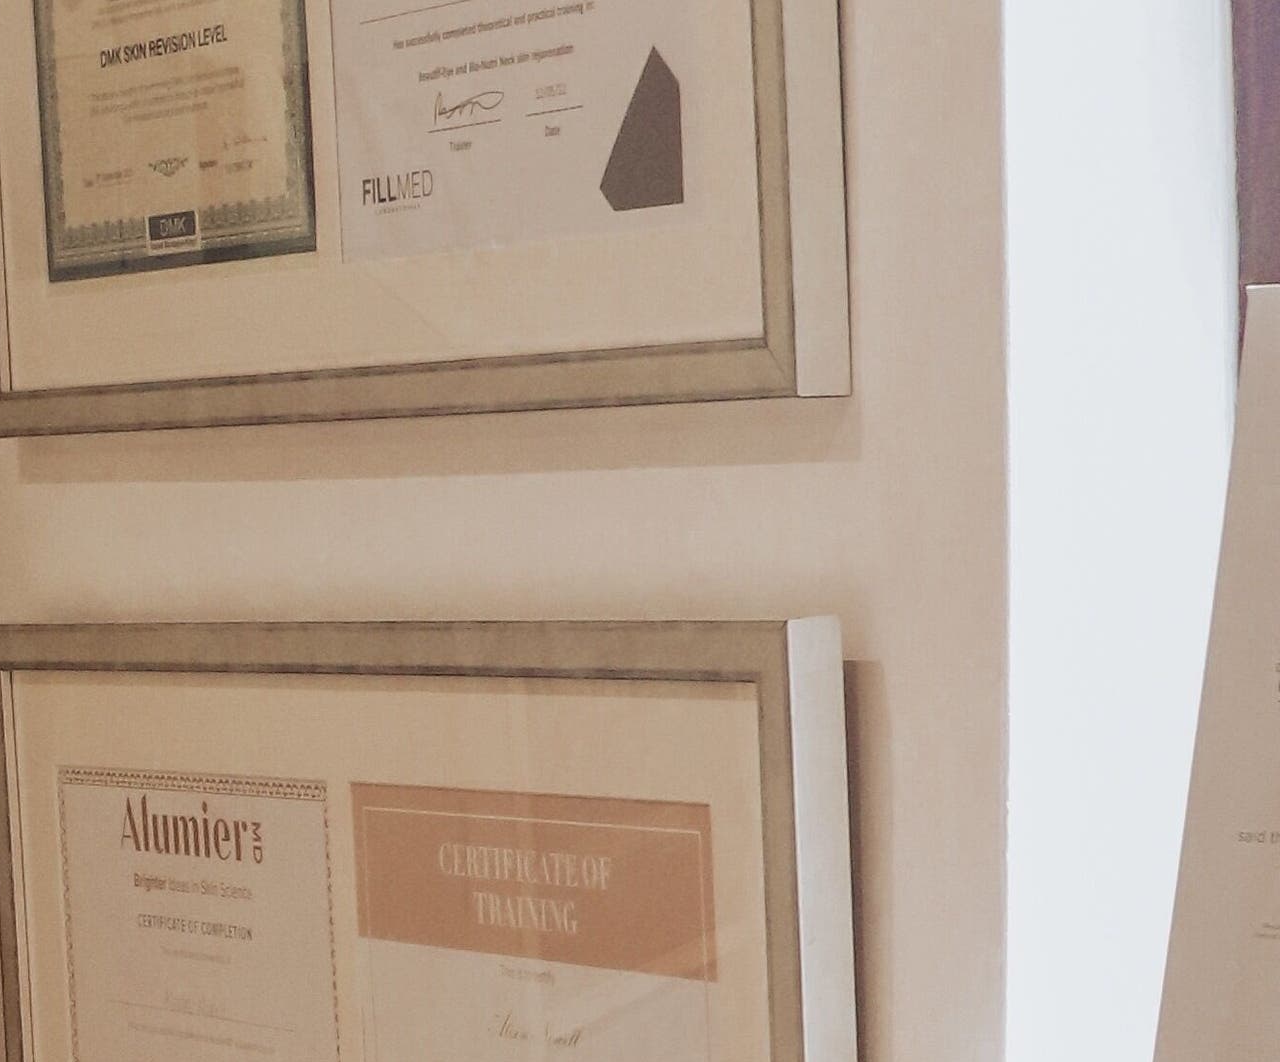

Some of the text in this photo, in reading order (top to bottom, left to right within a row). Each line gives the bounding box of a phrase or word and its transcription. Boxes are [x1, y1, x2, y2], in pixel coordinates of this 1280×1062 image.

[100, 24, 228, 68] DMK SKIN REVISION LEVEL
[362, 169, 433, 206] FILLMED
[438, 842, 612, 890] CERTIFICATE OF
[137, 912, 187, 933] CERTIFICATE
[200, 921, 253, 942] COMPLETION
[471, 891, 579, 934] TRAINING
